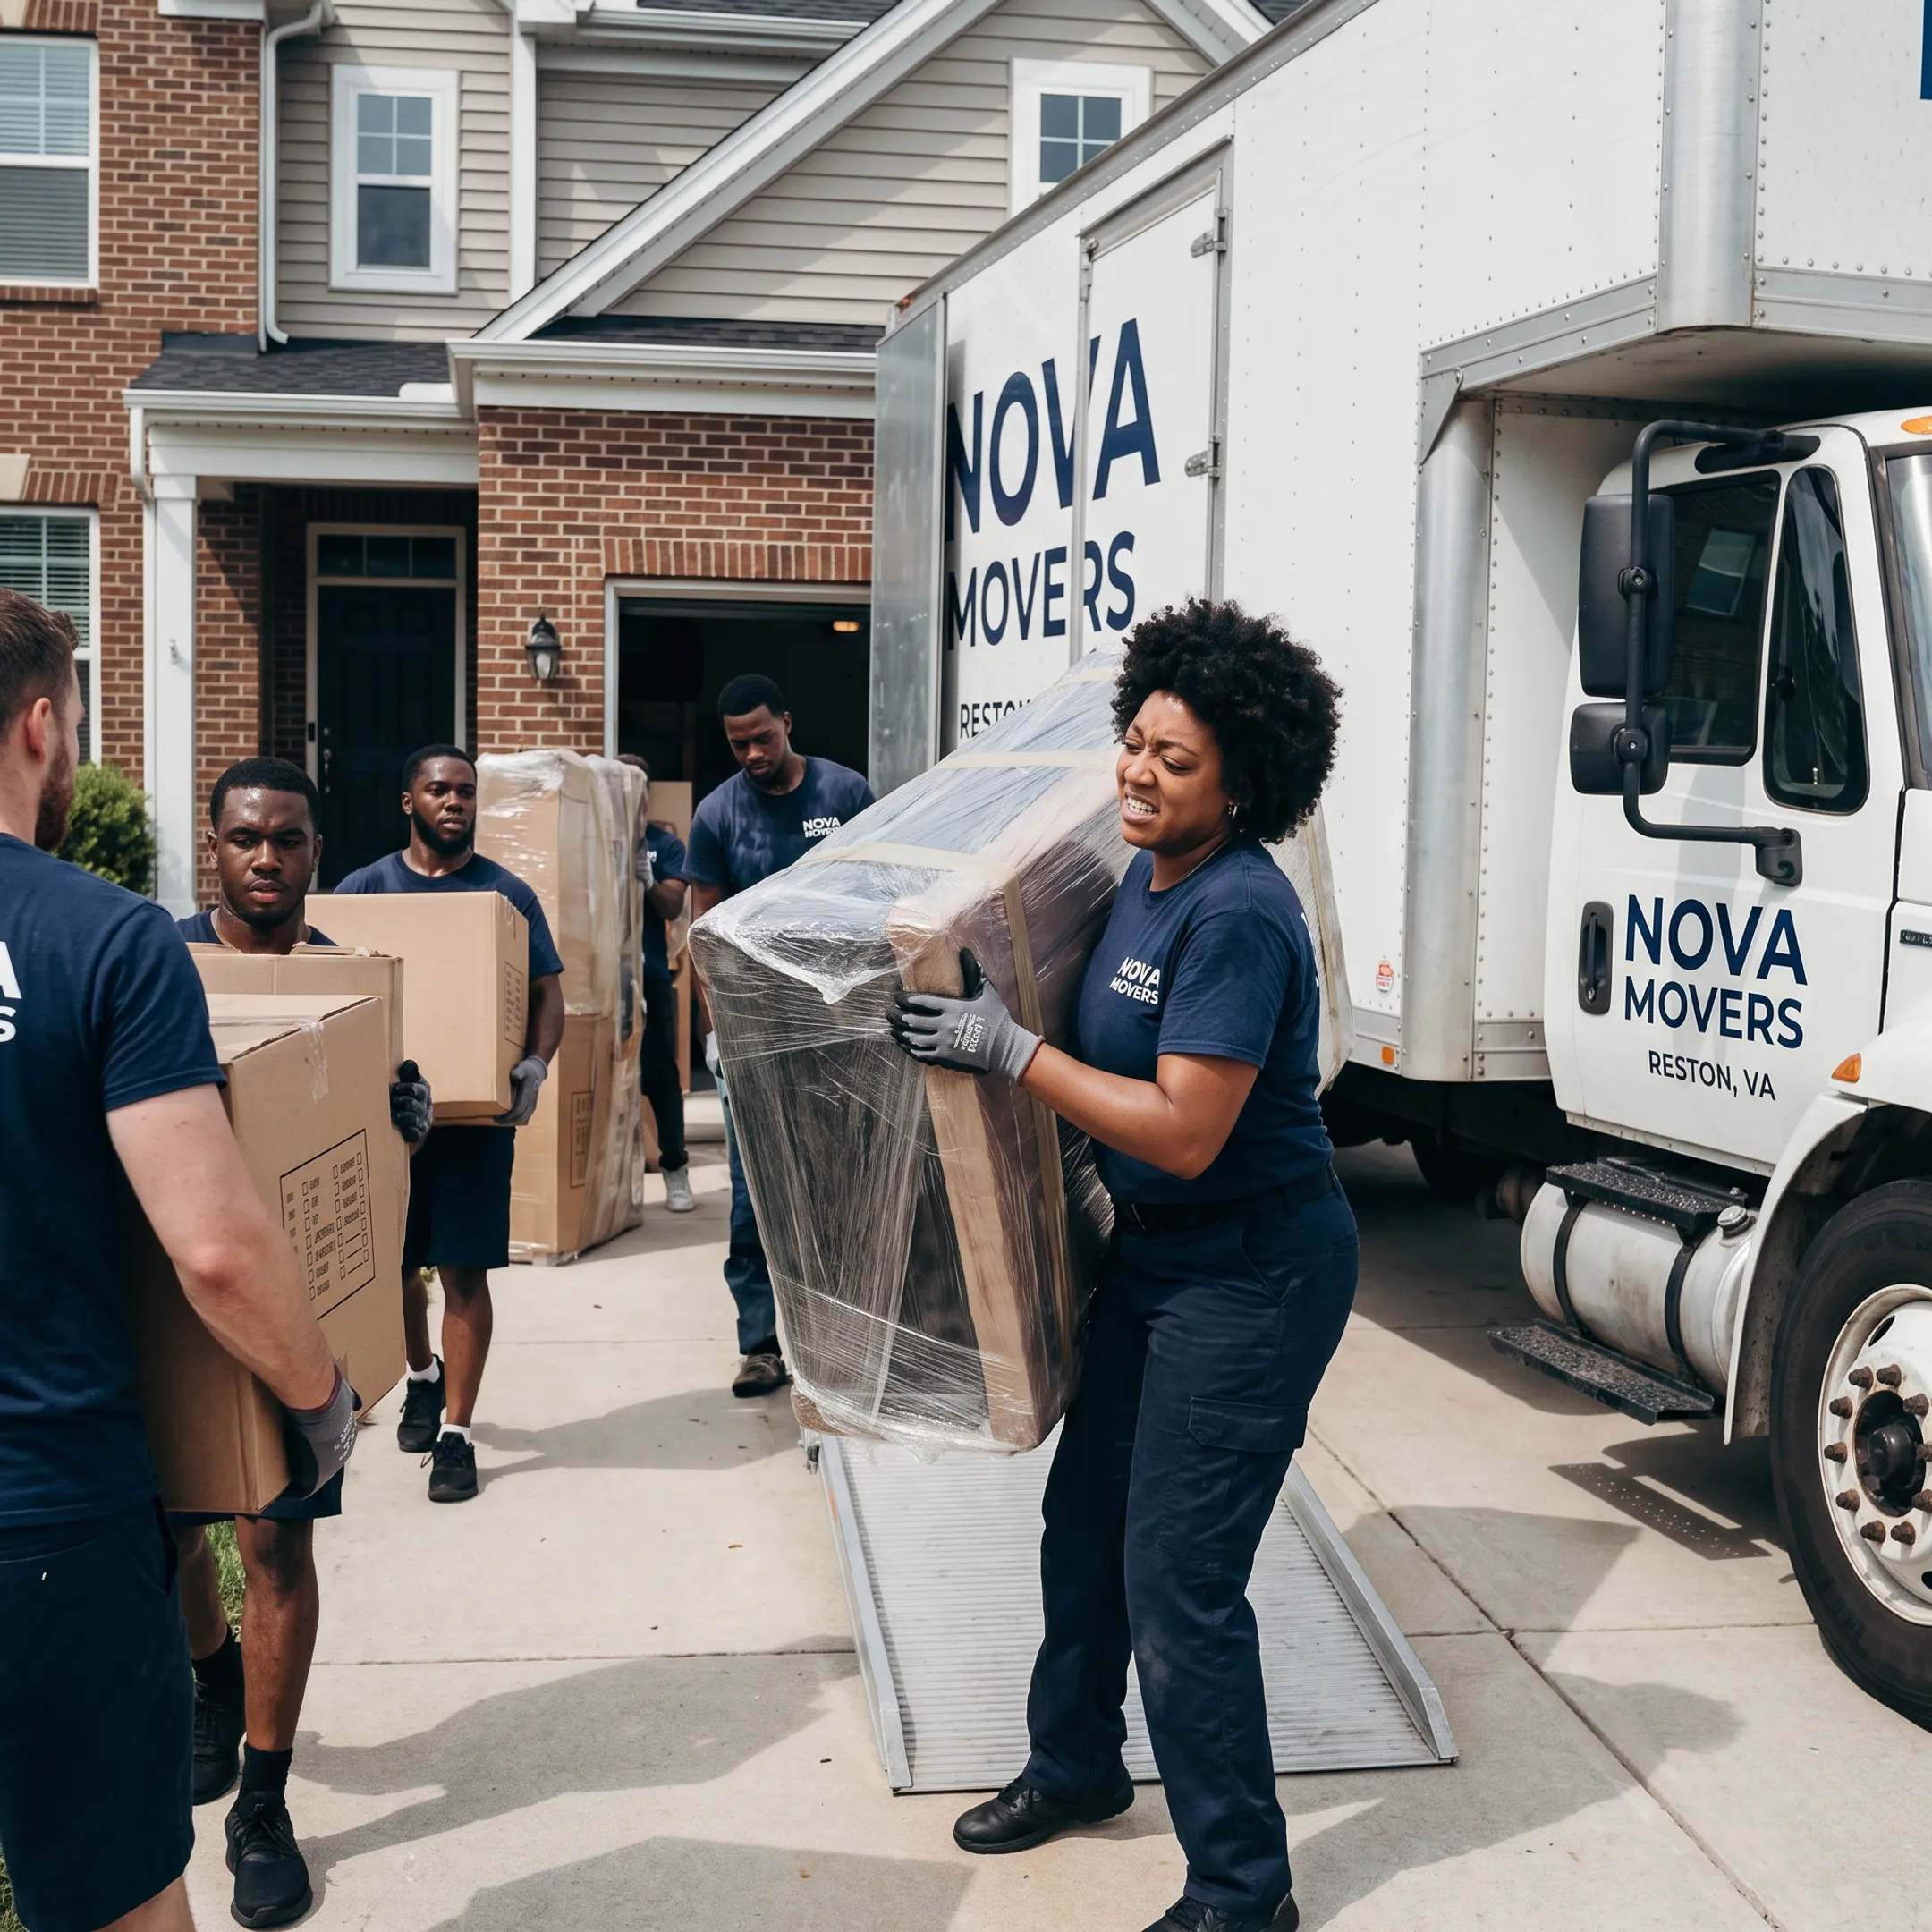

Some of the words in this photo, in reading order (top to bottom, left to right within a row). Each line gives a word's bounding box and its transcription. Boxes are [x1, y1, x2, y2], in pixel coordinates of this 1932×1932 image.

[946, 318, 1161, 541] NOVA
[947, 530, 1136, 651] MOVERS
[960, 699, 1030, 739] REST
[802, 816, 841, 832] NOVA
[1624, 894, 1809, 987] NOVA
[1109, 976, 1159, 1005] MOVERS
[1116, 956, 1161, 988] NOVA
[1624, 975, 1804, 1049] MOVERS
[1648, 1050, 1738, 1097] RESTON,
[1742, 1069, 1776, 1101] VA
